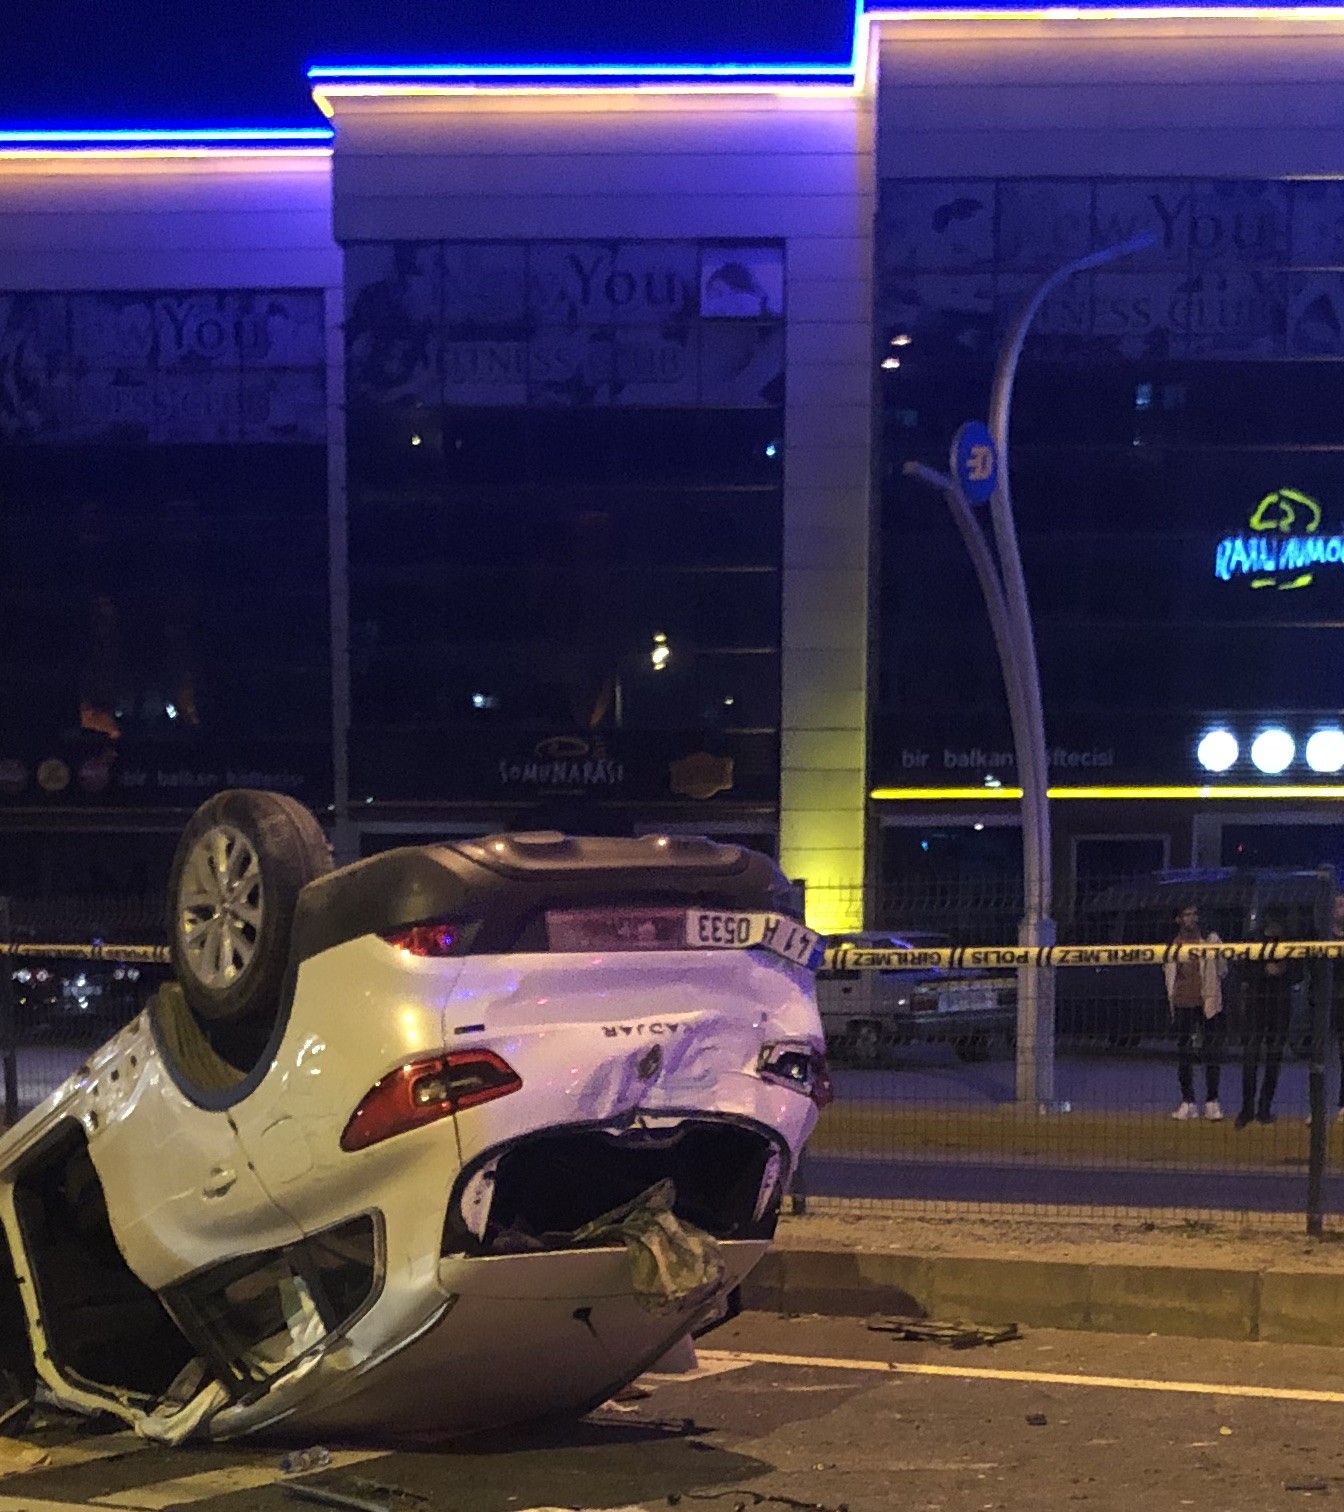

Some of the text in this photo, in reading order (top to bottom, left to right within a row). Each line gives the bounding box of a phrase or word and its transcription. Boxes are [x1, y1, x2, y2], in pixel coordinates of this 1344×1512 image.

[1150, 192, 1272, 250] You
[567, 253, 678, 306] You
[163, 302, 261, 351] You
[901, 749, 930, 769] bir
[943, 748, 1014, 769] balkan
[698, 915, 750, 943] 0533
[782, 928, 811, 960] 41
